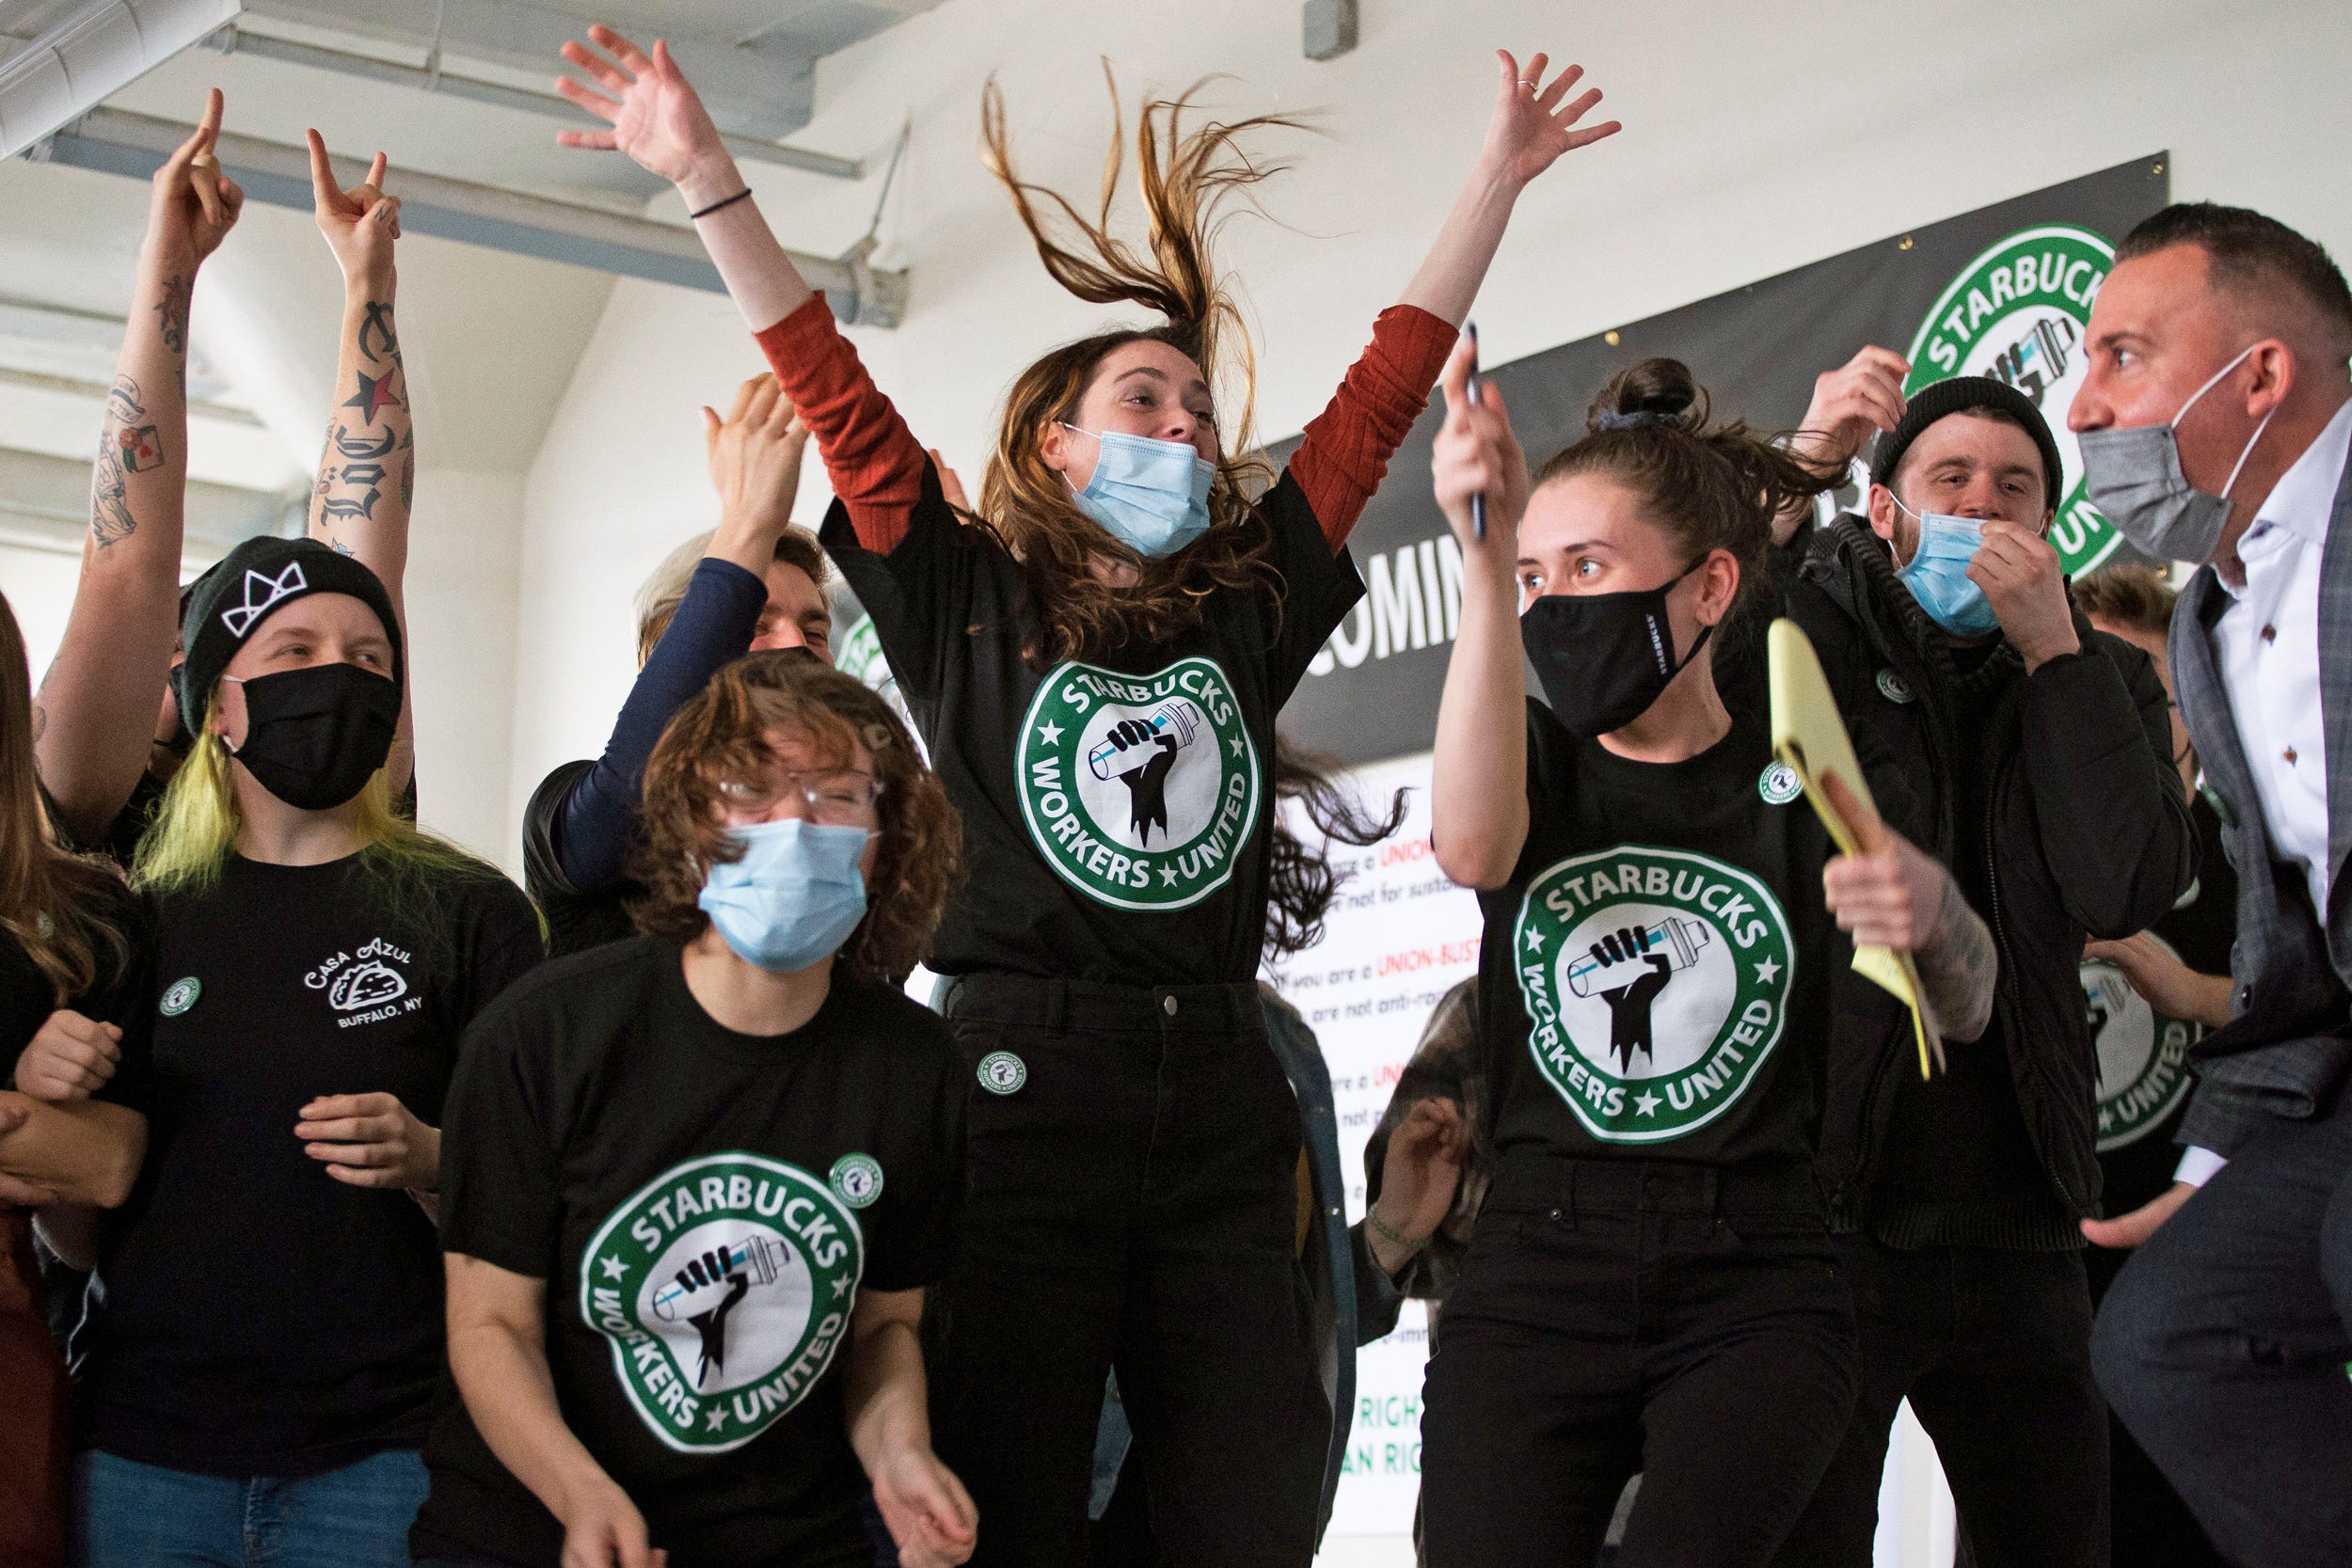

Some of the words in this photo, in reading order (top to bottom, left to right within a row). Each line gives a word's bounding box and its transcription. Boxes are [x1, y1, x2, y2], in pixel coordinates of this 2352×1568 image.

[1646, 613, 1667, 675] STARBUCKS
[1062, 669, 1232, 726] STARBUCKS
[1032, 755, 1151, 888] WORKERS
[1177, 772, 1247, 879] UNITED
[1546, 863, 1769, 949] STARBUCKS
[304, 951, 351, 990] CASA
[357, 937, 411, 964] AZUL
[404, 996, 422, 1011] NY
[1523, 962, 1627, 1117] WORKERS
[1664, 999, 1773, 1112] UNITED
[2116, 1021, 2187, 1123] UNITED
[631, 1175, 847, 1269] STARBUCKS
[594, 1287, 699, 1429] WORKERS
[732, 1312, 842, 1424] UNITED
